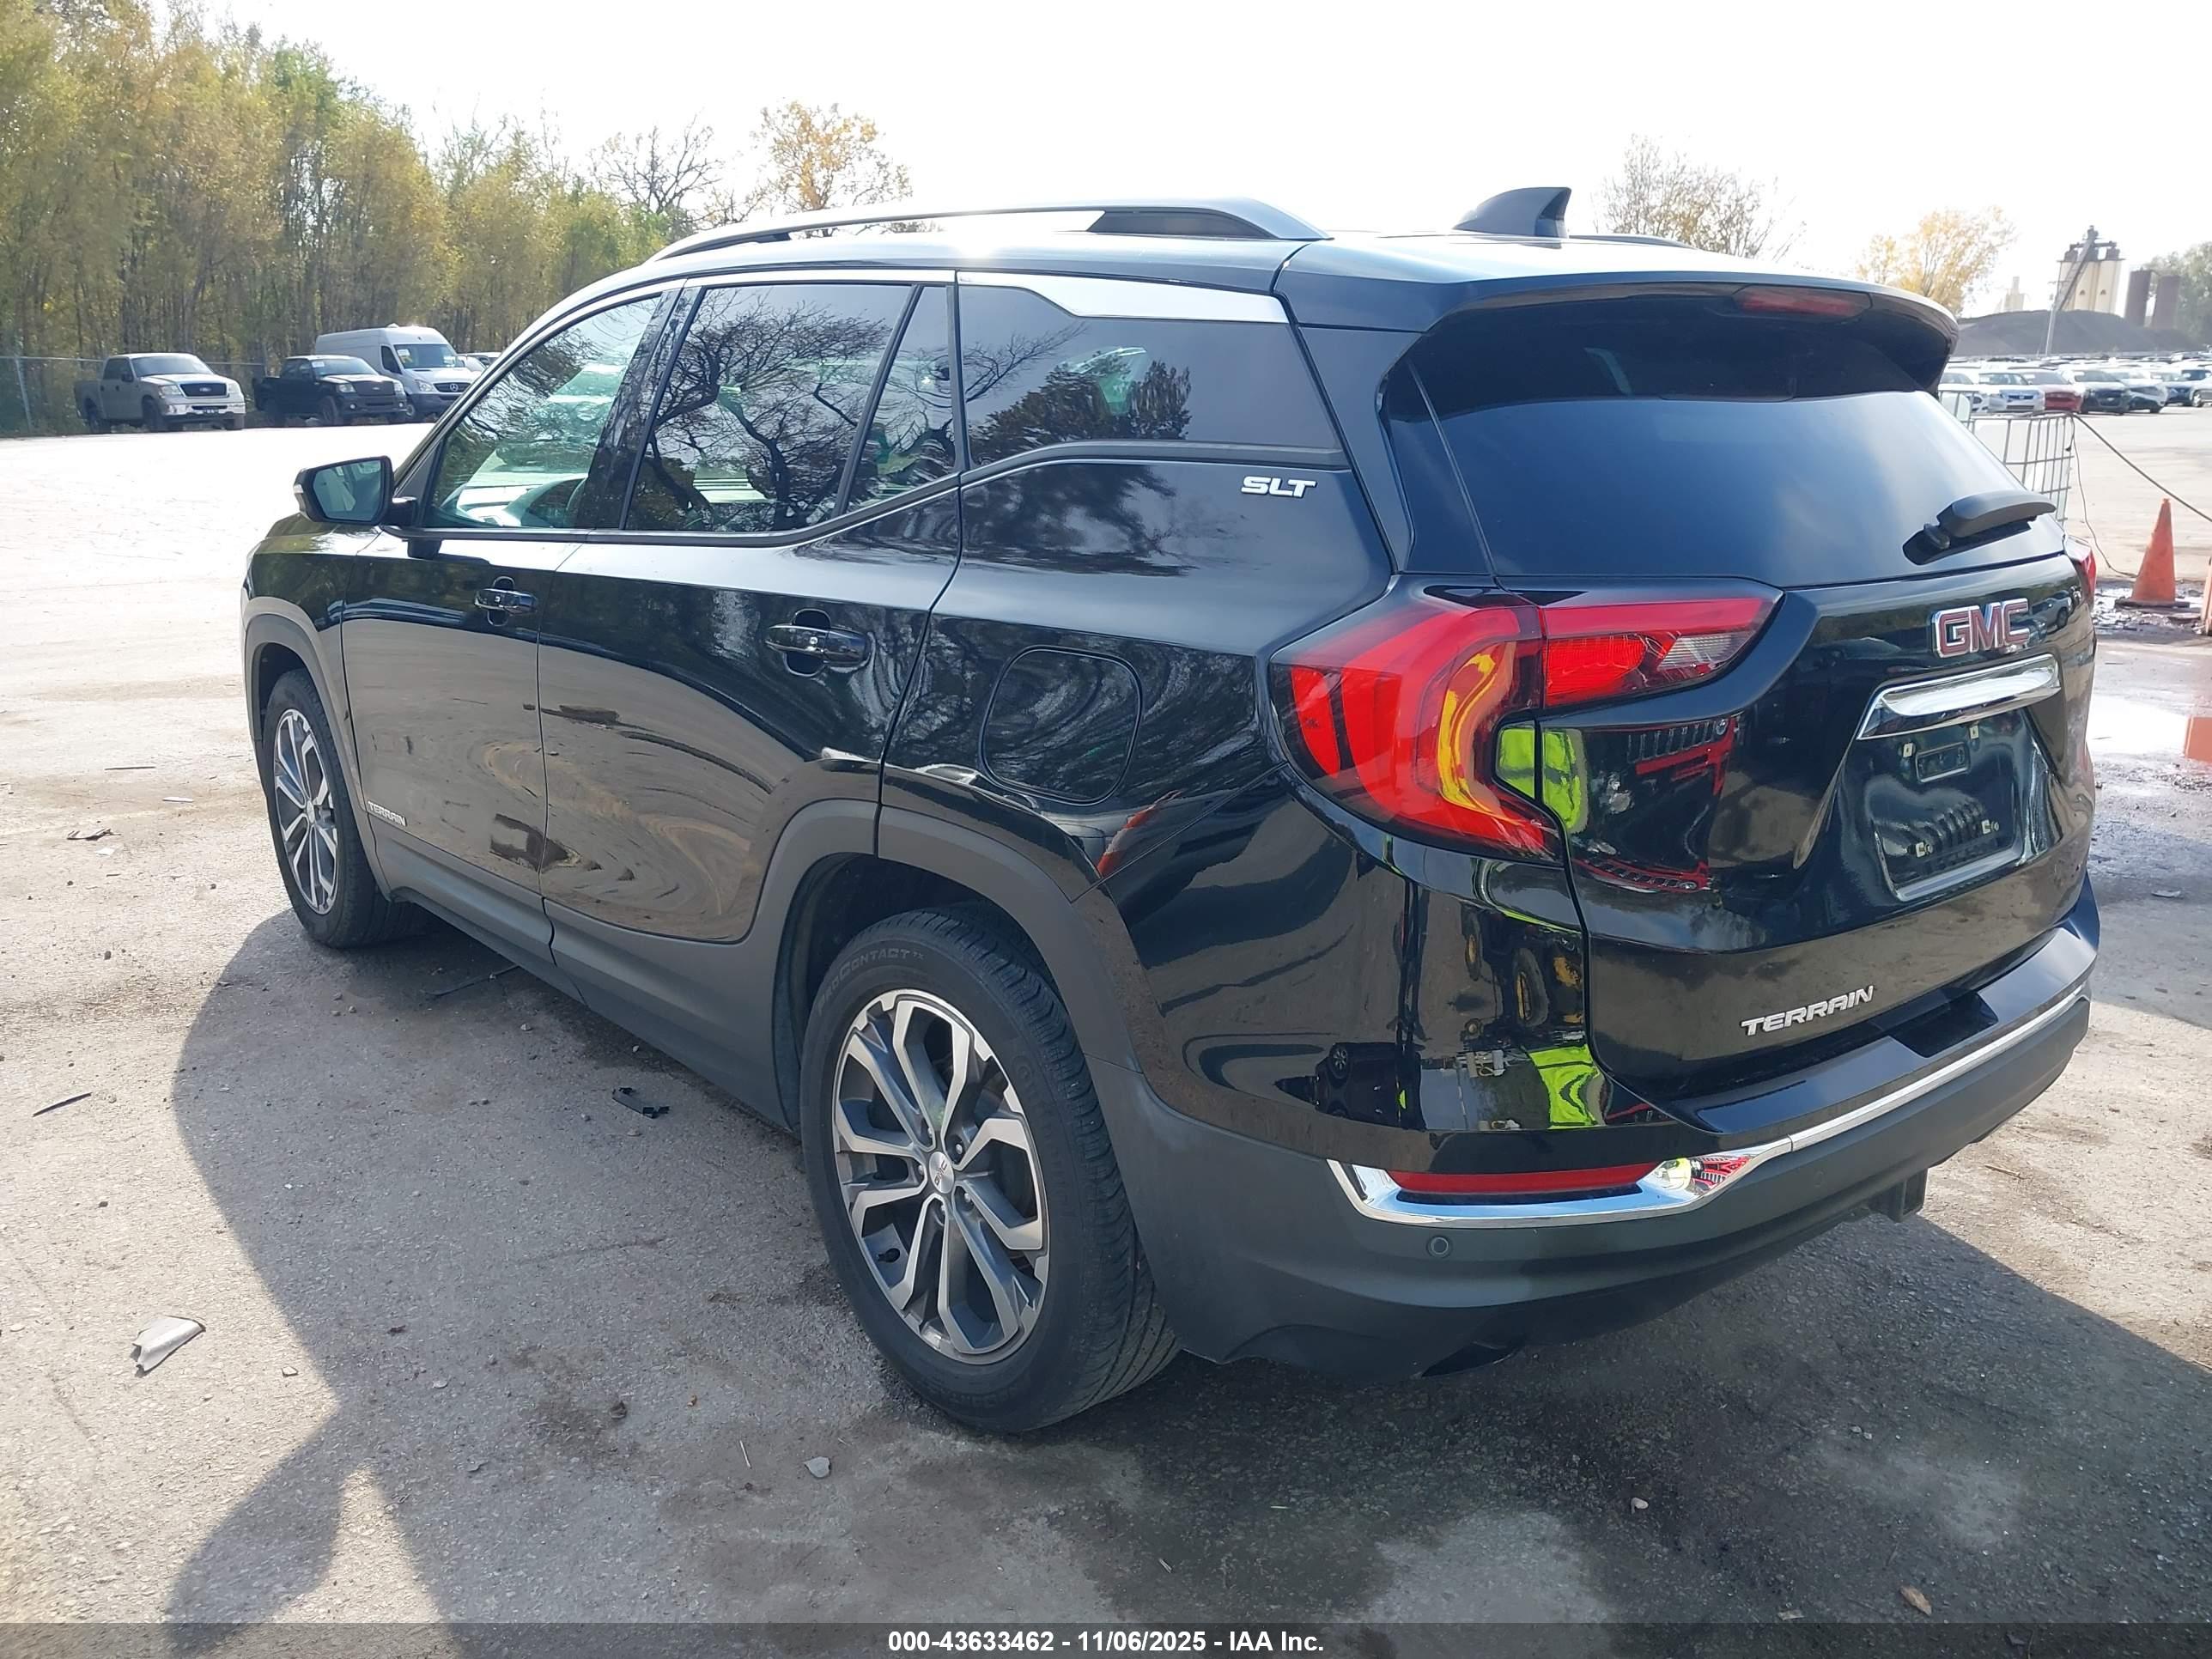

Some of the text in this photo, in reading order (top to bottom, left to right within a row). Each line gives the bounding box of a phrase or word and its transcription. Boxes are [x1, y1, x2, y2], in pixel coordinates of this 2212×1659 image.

[1241, 476, 1317, 498] SLT
[1933, 598, 2030, 659] GMC
[368, 800, 406, 827] TERRAIN
[1741, 985, 1875, 1036] TERRAIN
[934, 1160, 948, 1186] GMC
